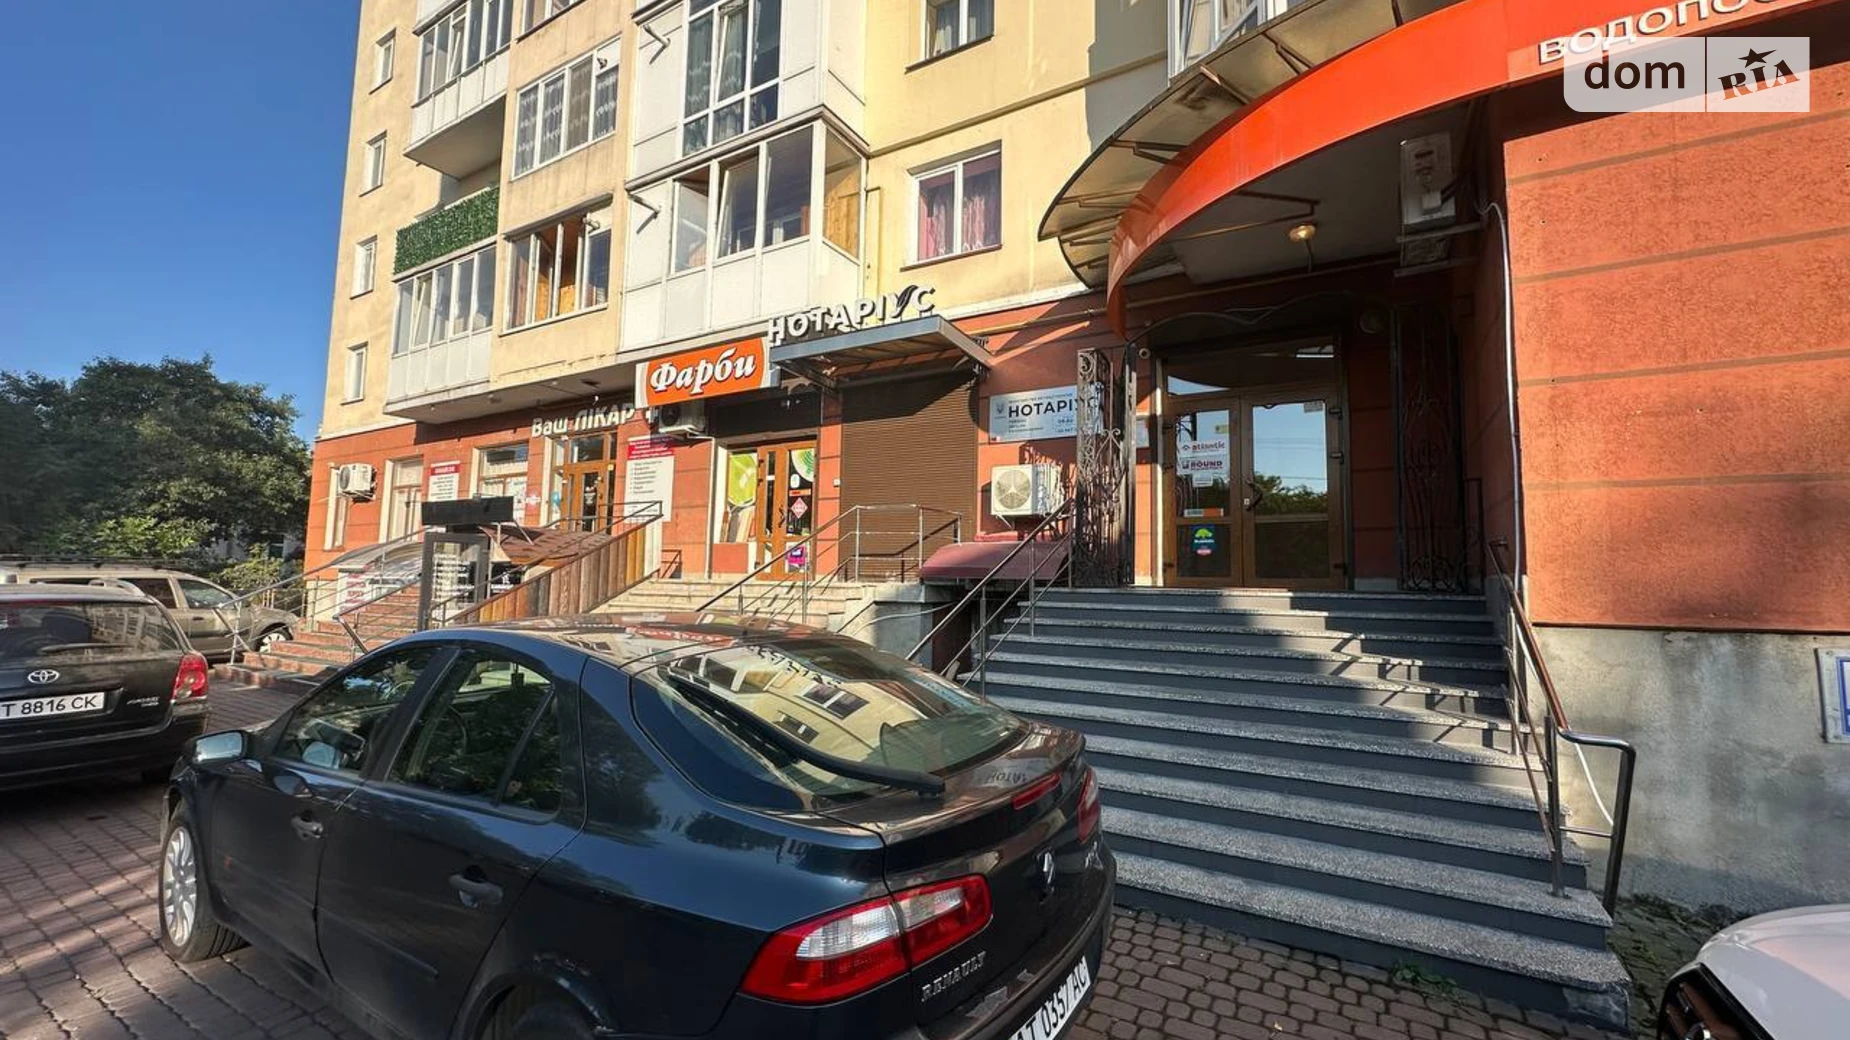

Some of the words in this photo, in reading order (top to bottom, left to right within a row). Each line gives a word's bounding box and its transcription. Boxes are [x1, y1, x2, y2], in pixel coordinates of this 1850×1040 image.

[768, 284, 936, 343] НОТАРІУС
[650, 347, 756, 395] Фарби
[532, 417, 568, 438] Ваш
[574, 402, 635, 431] ЛІКАР
[21, 699, 66, 715] 8816
[71, 696, 96, 709] CK
